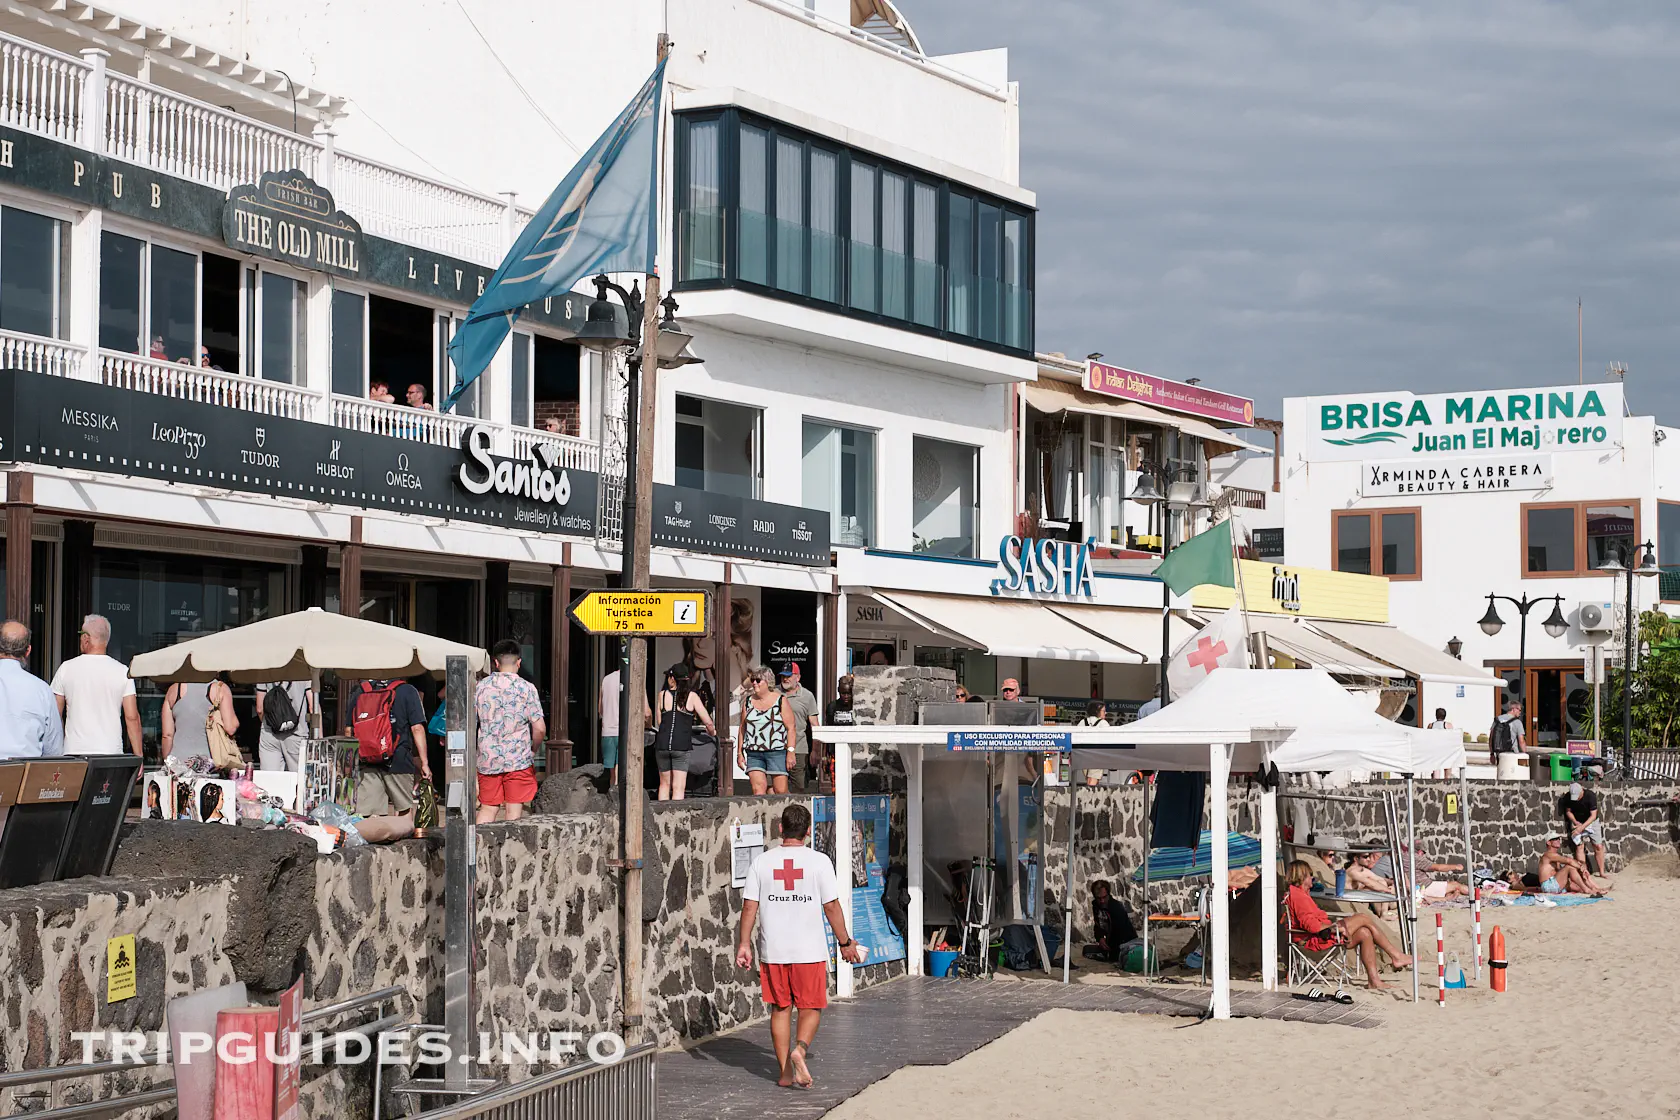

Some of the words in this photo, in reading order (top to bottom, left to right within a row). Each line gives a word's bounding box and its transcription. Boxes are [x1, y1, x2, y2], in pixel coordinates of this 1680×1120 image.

[277, 188, 300, 203] IRISH
[304, 196, 318, 209] BAR
[234, 208, 273, 249] THE
[277, 220, 311, 258] OLD
[316, 231, 359, 272] MILL
[1106, 367, 1125, 390] Indian
[1126, 374, 1153, 399] Delights
[1320, 399, 1432, 431] BRISA
[1445, 389, 1607, 424] MARINA
[61, 407, 119, 432] MESSIKA
[84, 433, 99, 443] PARIS
[1411, 431, 1466, 453] Juan
[1472, 428, 1494, 449] El
[240, 449, 280, 469] TUDOR
[458, 424, 572, 506] Santos
[316, 461, 355, 480] HUBLOT
[1460, 463, 1542, 478] CABRERA
[385, 470, 423, 490] OMEGA
[1398, 481, 1455, 493] BEAUTY
[1463, 480, 1469, 489] &
[1478, 478, 1510, 489] HAIR
[514, 506, 551, 529] Jewellery
[552, 515, 559, 526] &
[559, 515, 592, 531] watches
[708, 514, 737, 528] LONGINES
[753, 519, 775, 534] RADO
[791, 528, 813, 542] TISSOT
[1000, 534, 1097, 597] SASHA
[107, 602, 131, 612] TUDOR
[598, 595, 661, 605] Información
[857, 606, 884, 622] SASHA
[615, 620, 628, 630] 75
[635, 622, 645, 630] m
[768, 640, 810, 655] Santos
[768, 894, 790, 902] Cruz
[792, 893, 813, 903] Roja
